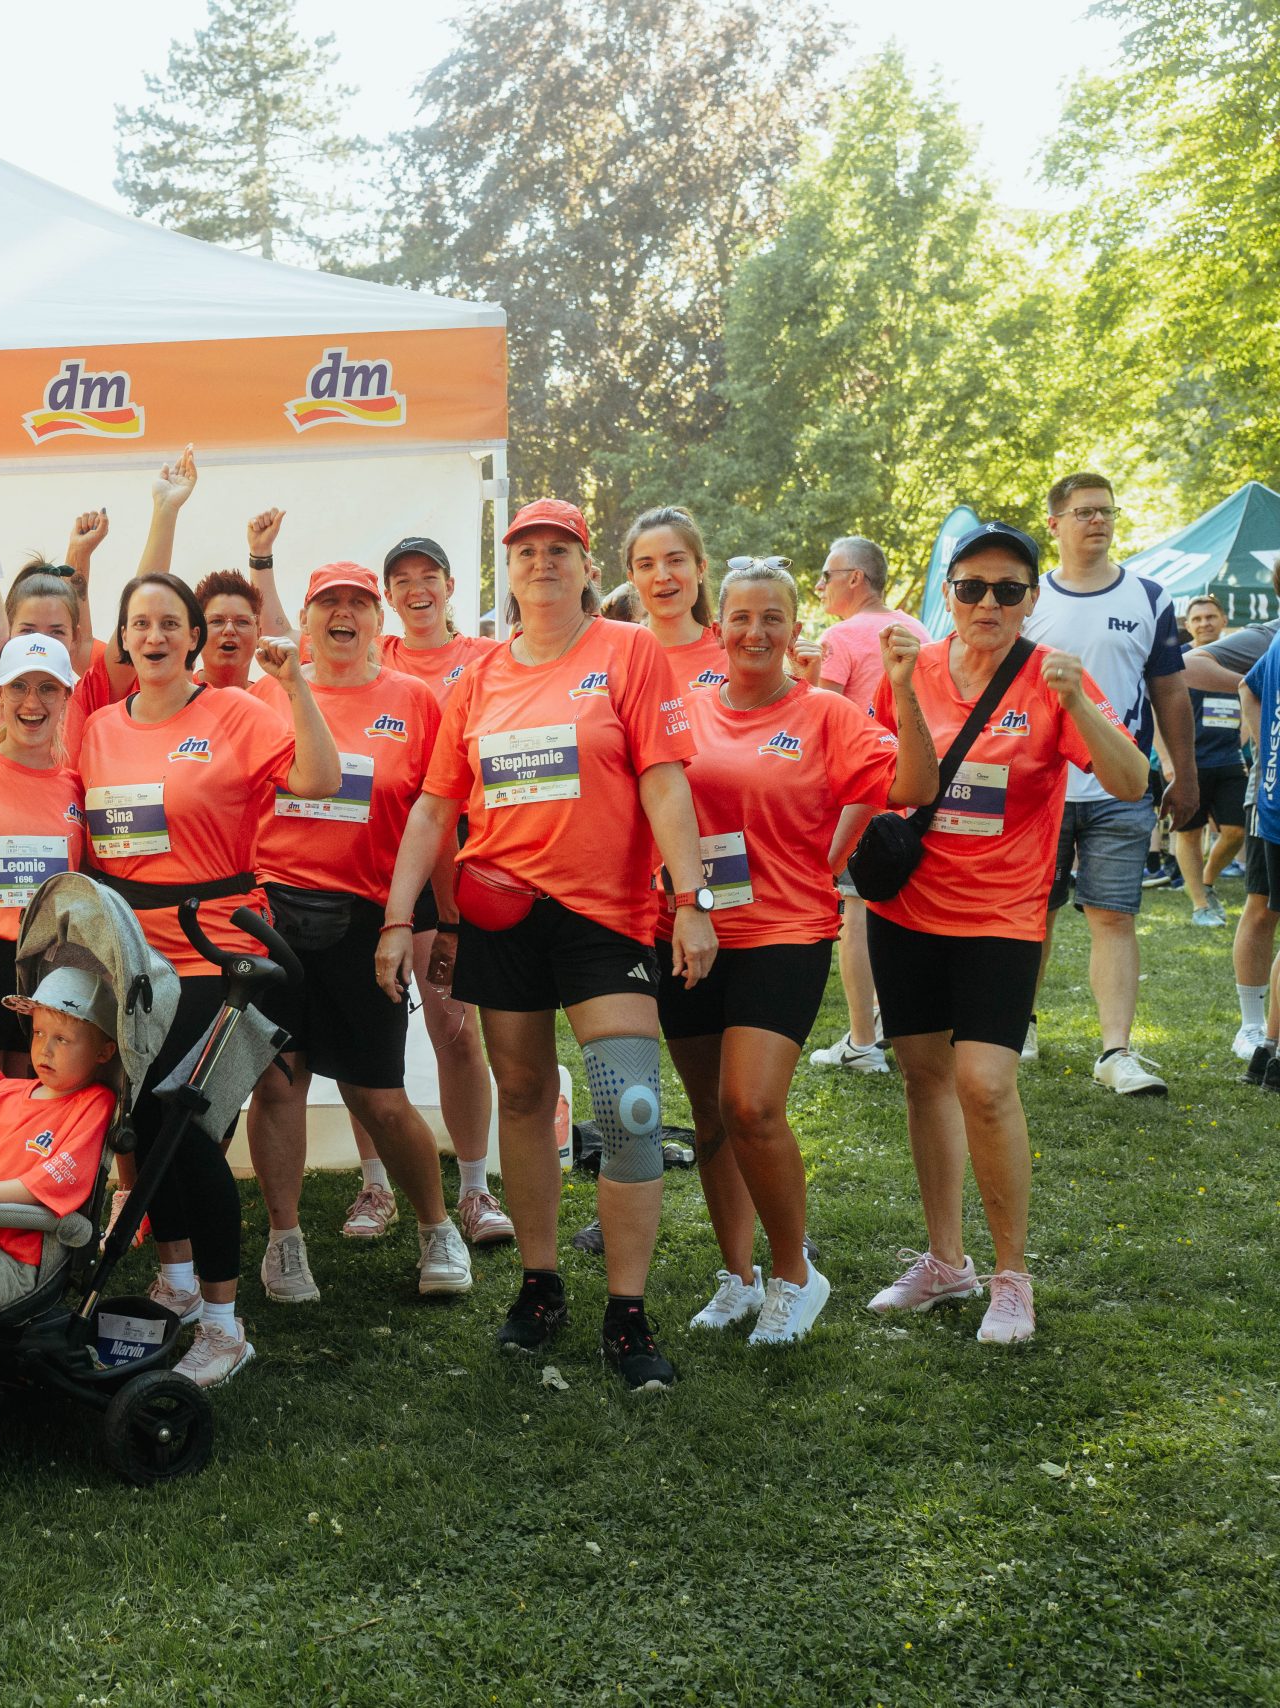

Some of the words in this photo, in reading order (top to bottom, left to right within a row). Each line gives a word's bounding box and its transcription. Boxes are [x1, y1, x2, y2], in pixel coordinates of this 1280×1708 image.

[309, 351, 389, 400] dm
[47, 362, 127, 411] dm
[1108, 617, 1140, 633] R+V
[30, 644, 46, 652] dm
[698, 670, 725, 684] dm
[375, 715, 405, 731] dm
[178, 738, 209, 752] dm
[769, 732, 799, 749] dm
[491, 749, 564, 772] Stephanie
[516, 770, 537, 780] 1707
[496, 790, 507, 799] dm
[288, 801, 300, 810] dm
[105, 809, 134, 824] Sina
[112, 826, 129, 834] 1702
[0, 859, 46, 873] Leonie
[14, 875, 34, 884] 1696
[52, 1155, 77, 1185] anders
[110, 1340, 145, 1358] Marvin
